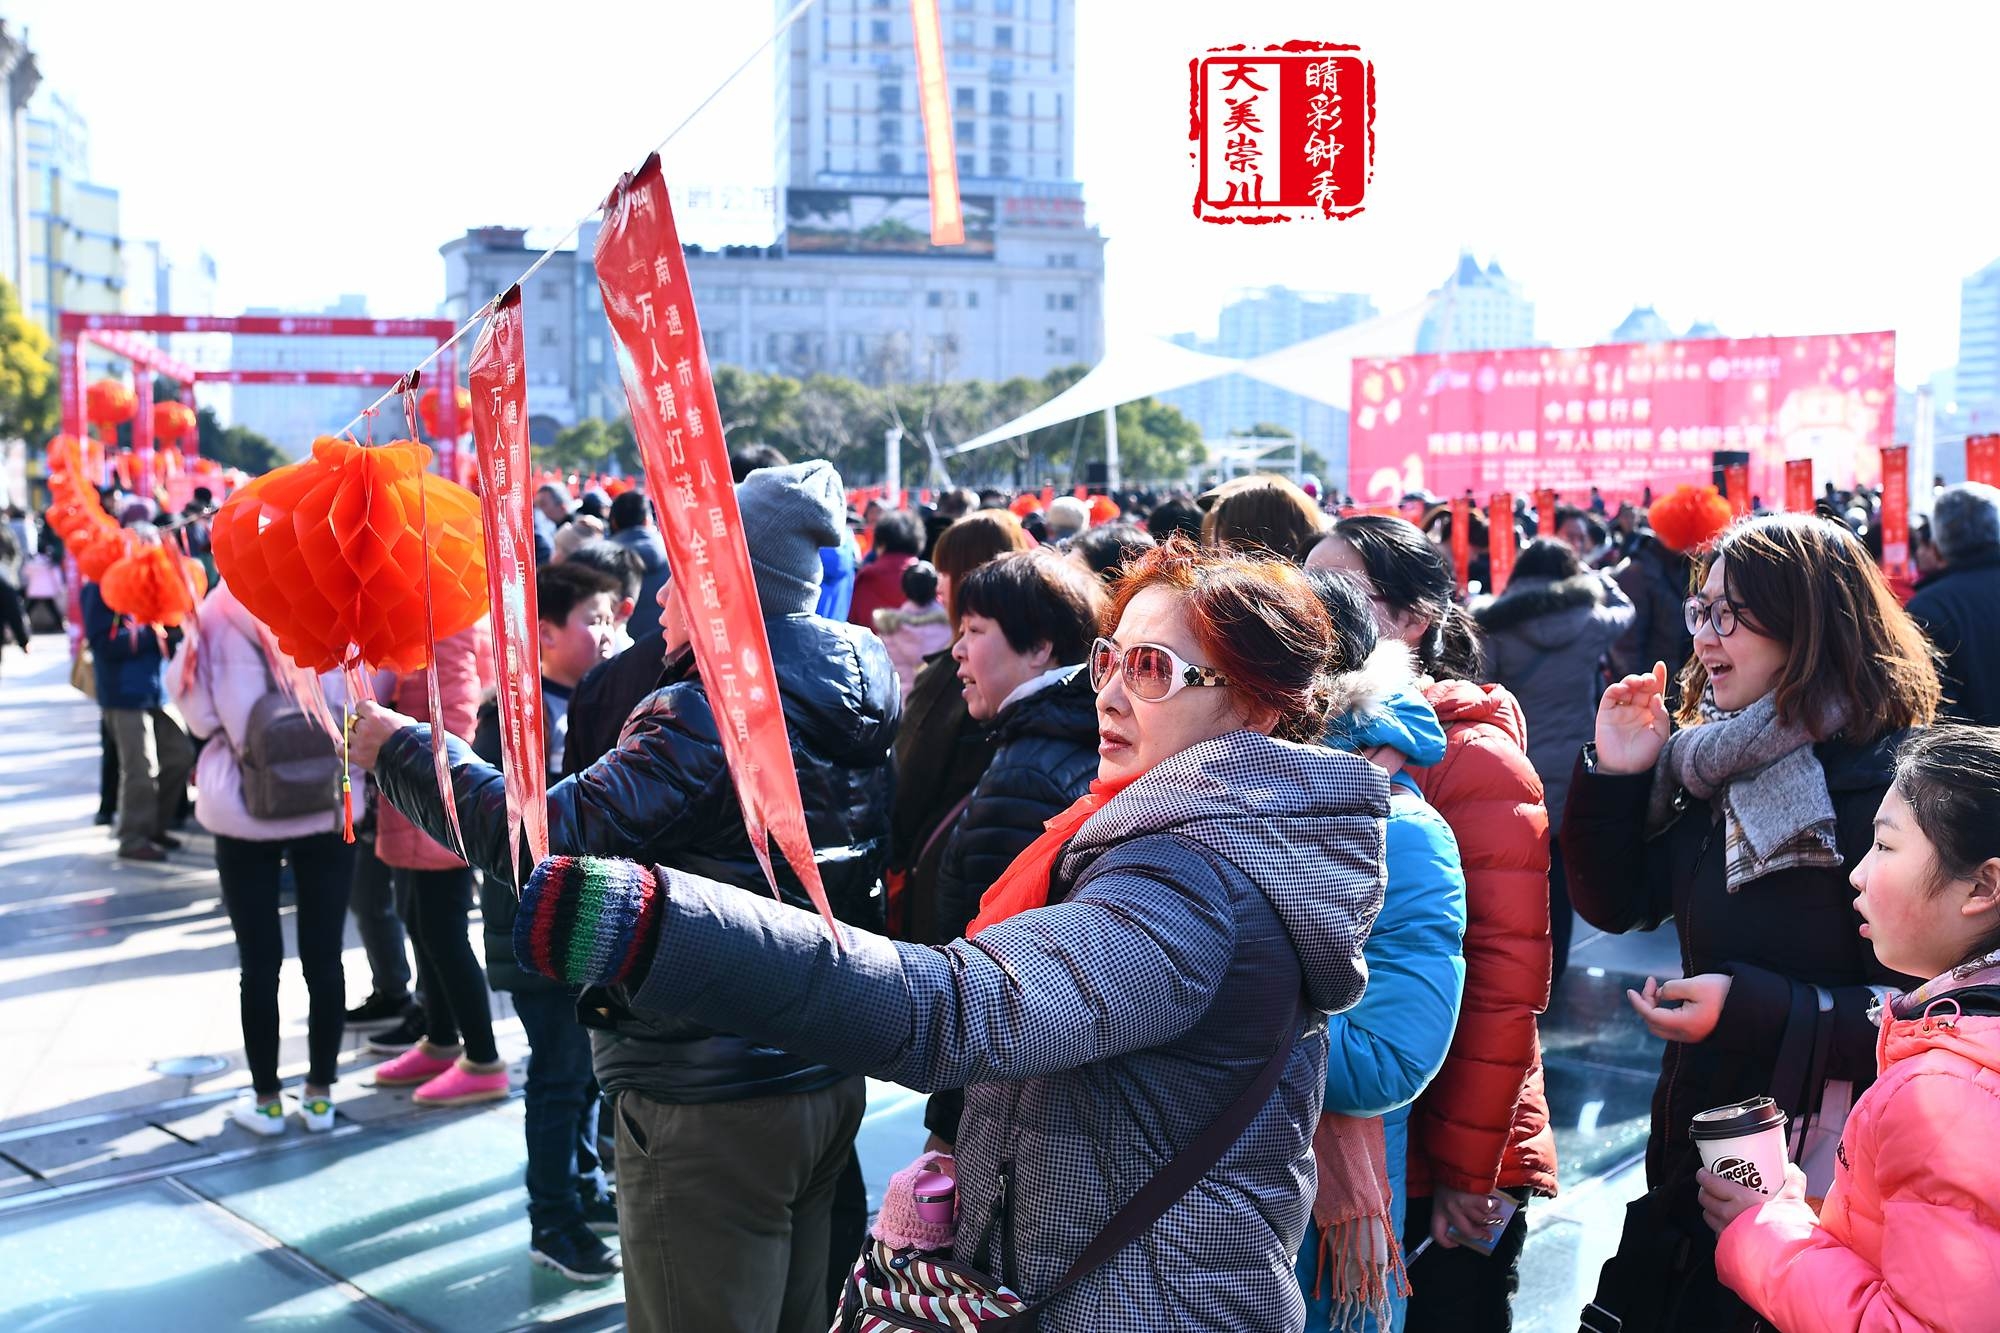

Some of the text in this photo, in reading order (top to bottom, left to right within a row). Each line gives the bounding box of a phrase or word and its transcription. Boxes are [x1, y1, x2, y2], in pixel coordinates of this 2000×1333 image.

[654, 256, 727, 538] 南通市第八届
